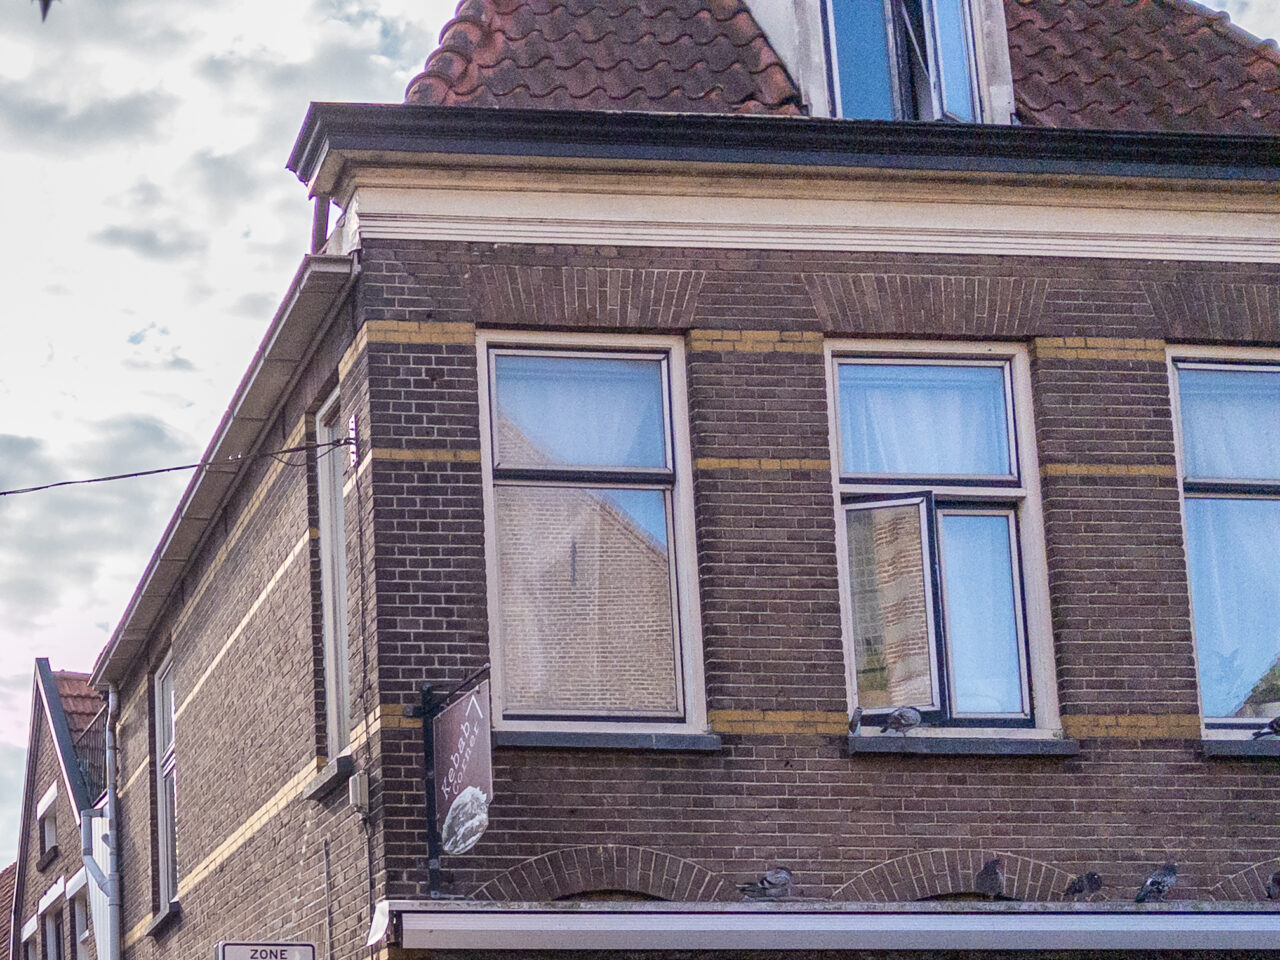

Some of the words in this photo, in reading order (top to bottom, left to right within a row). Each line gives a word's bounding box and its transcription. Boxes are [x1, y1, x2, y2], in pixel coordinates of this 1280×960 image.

[441, 721, 470, 800] Kebab
[452, 721, 480, 795] Corner
[250, 949, 288, 960] ZONE
